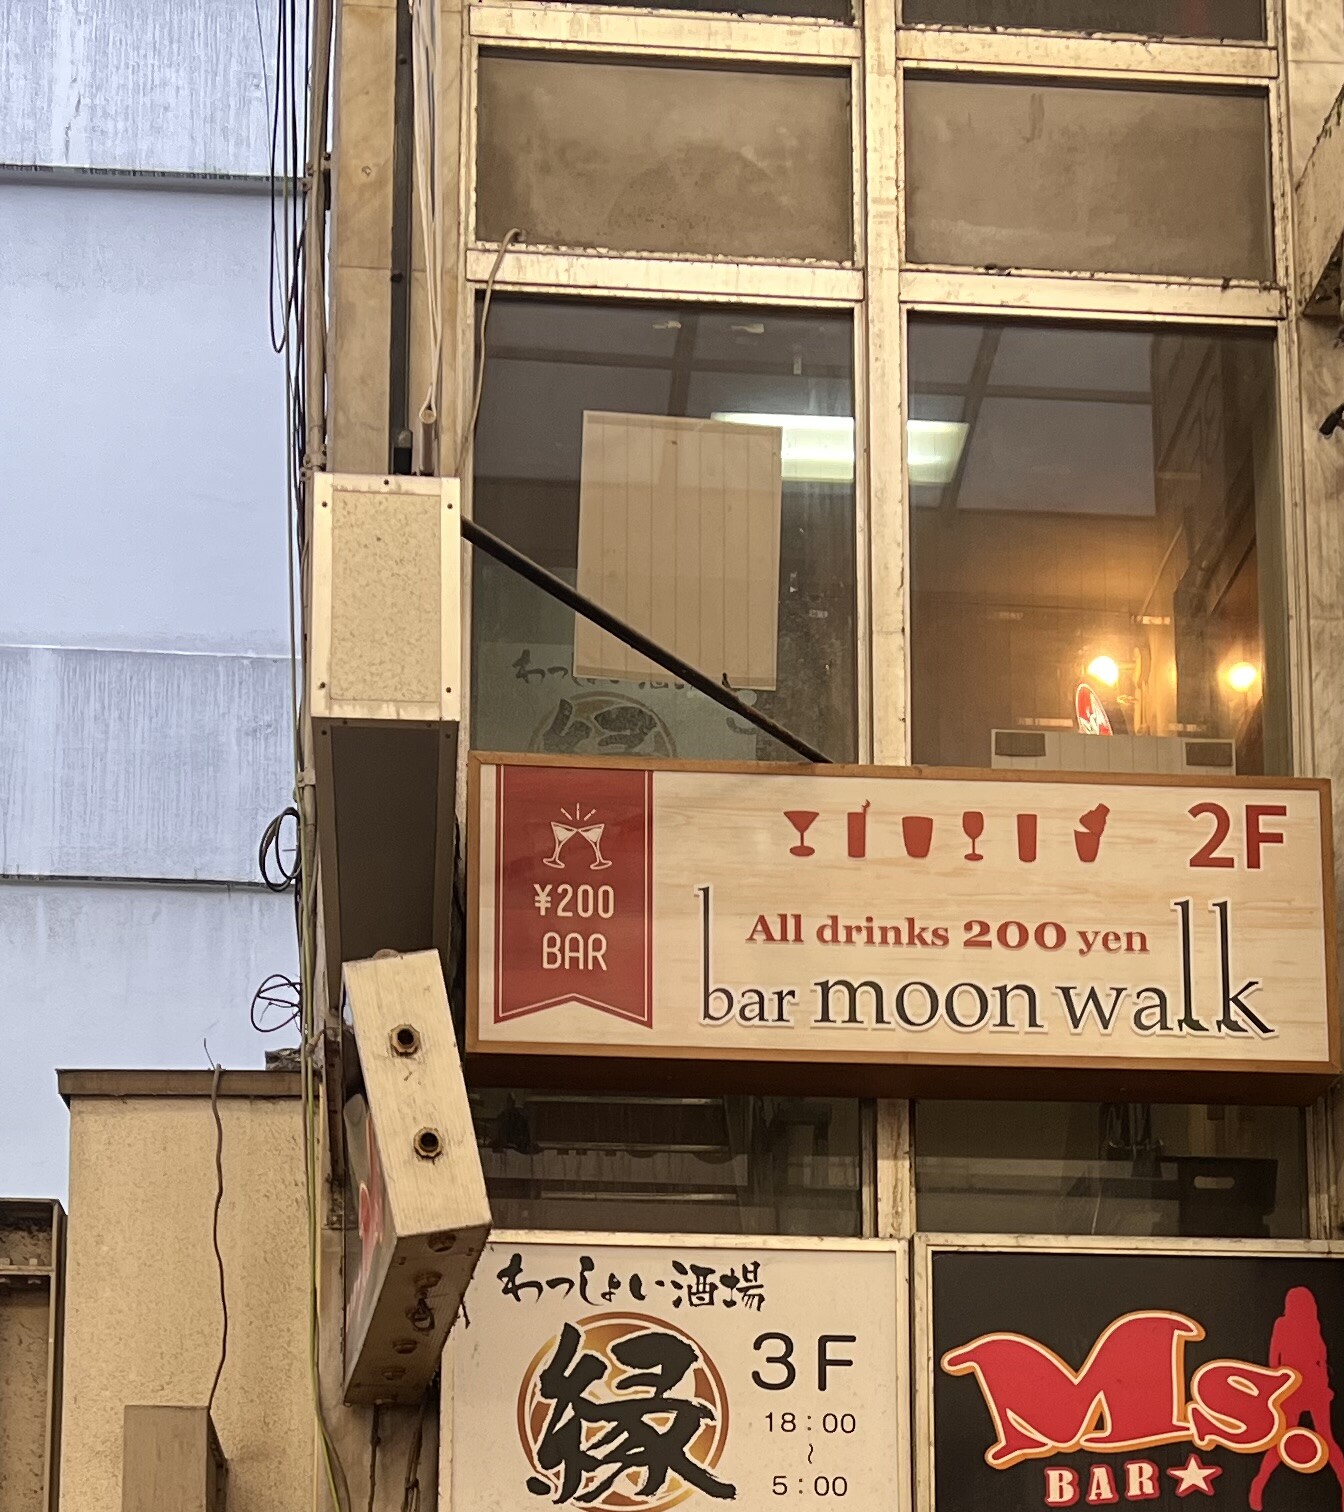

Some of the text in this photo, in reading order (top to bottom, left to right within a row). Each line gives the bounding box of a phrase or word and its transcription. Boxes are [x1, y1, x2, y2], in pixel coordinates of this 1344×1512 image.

[1189, 802, 1288, 870] 2F
[533, 884, 615, 920] ¥200
[542, 932, 608, 972] BAR
[746, 913, 1148, 957] All drinks 200 yen
[699, 885, 1275, 1036] bar moon walk
[498, 1261, 766, 1312] わっしょい酒場
[752, 1331, 858, 1392] 3F
[529, 1321, 737, 1503] 縁
[764, 1412, 858, 1436] 18:00
[772, 1475, 849, 1497] 5:00
[1045, 1458, 1158, 1508] BAR
